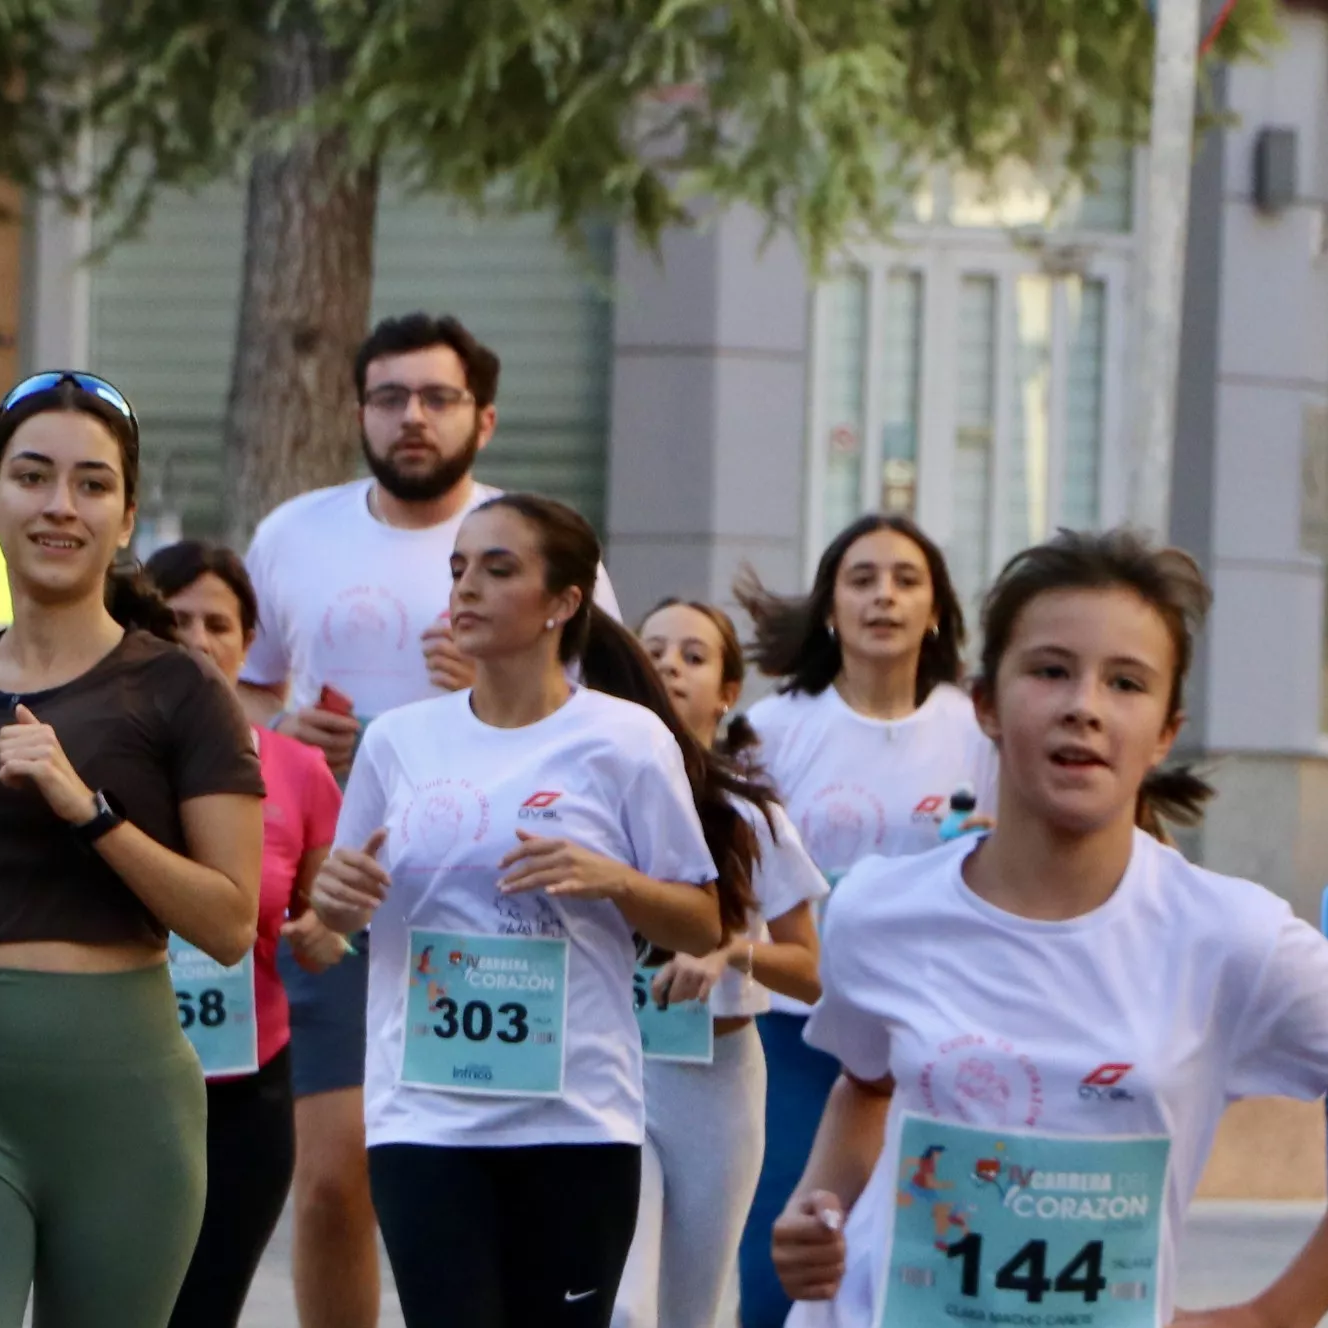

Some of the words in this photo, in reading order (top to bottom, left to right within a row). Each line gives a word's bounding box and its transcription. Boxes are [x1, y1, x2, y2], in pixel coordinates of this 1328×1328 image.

[433, 996, 530, 1045] 303
[1008, 1164, 1034, 1188] IV
[1030, 1172, 1113, 1193] CARRERA
[947, 1233, 1106, 1303] 144
